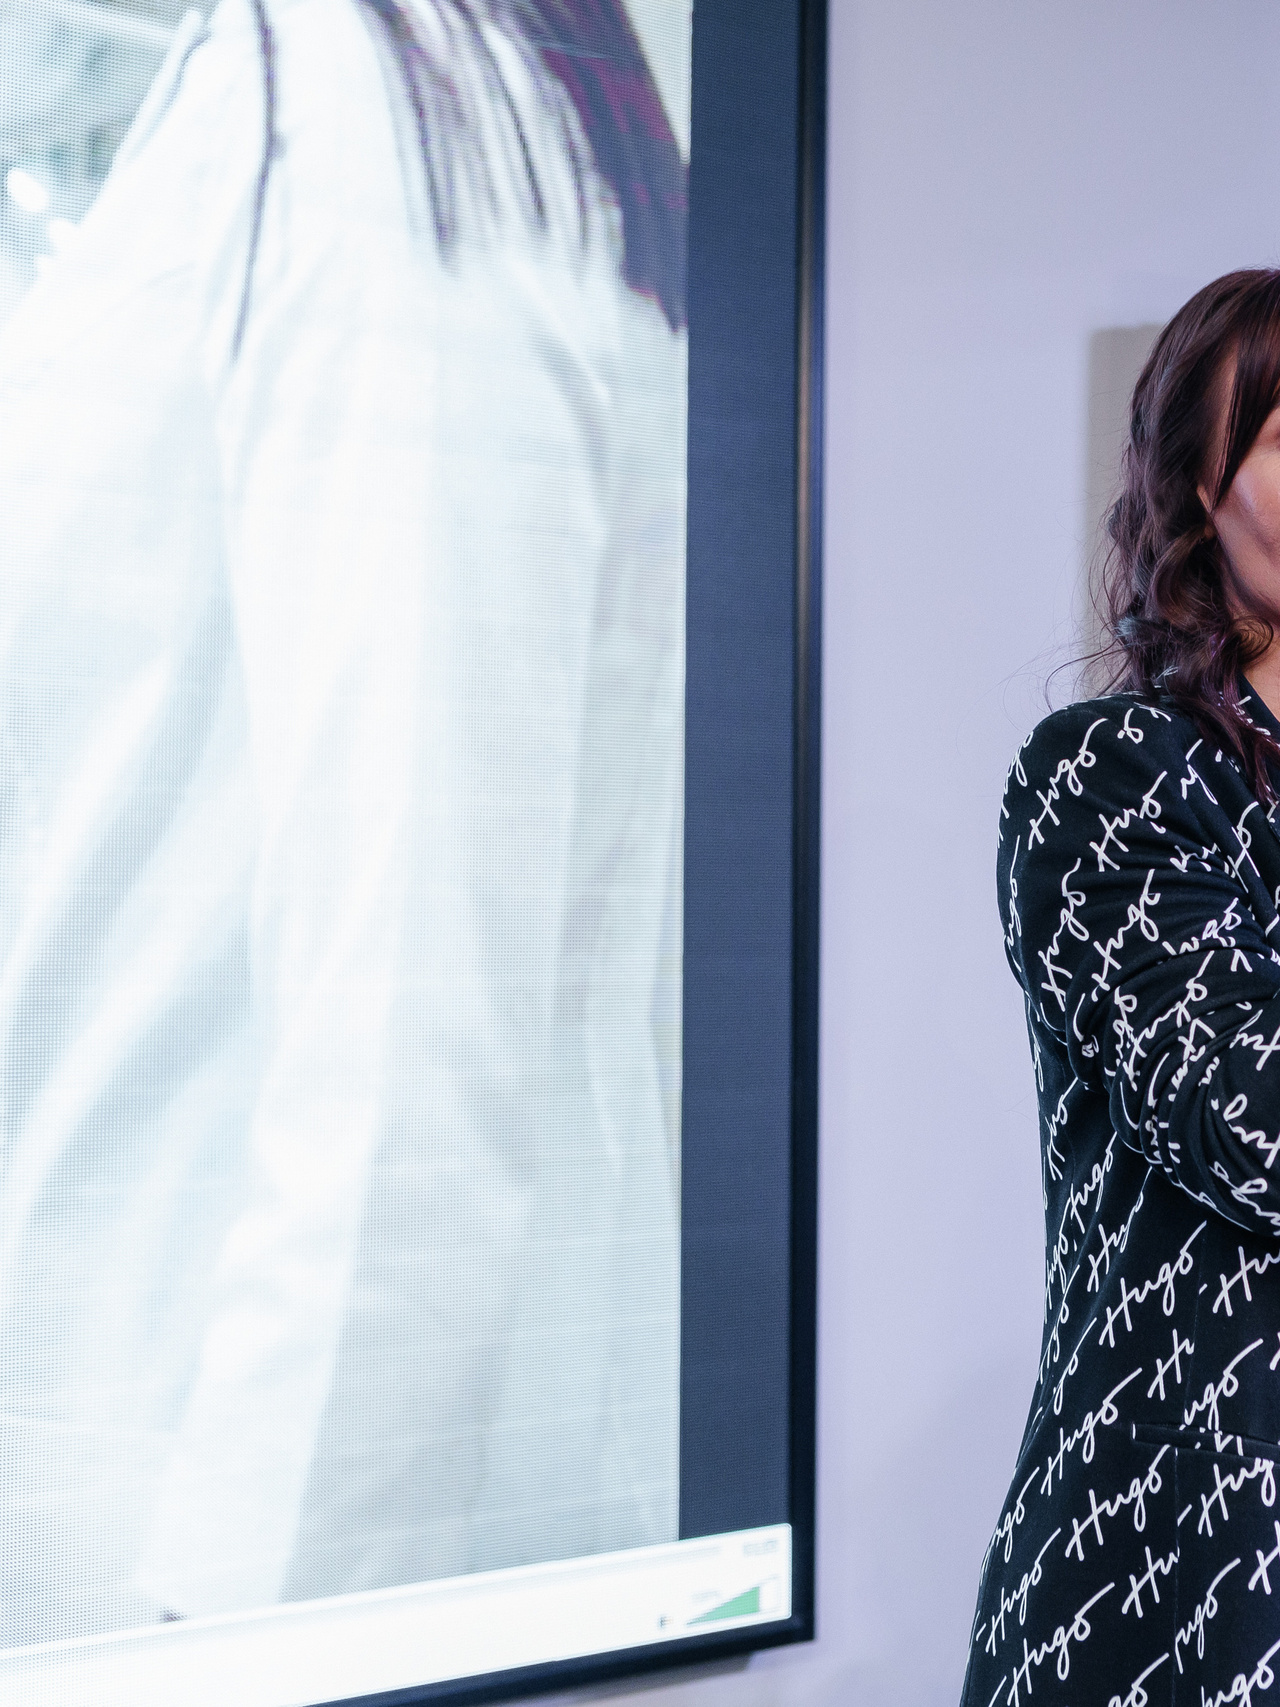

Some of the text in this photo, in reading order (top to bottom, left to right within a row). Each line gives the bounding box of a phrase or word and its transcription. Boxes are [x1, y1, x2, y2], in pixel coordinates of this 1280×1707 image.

[1028, 718, 1109, 851] Hugo
[1037, 857, 1090, 1013] Hugo
[1099, 1219, 1208, 1348] Hugo
[1040, 1367, 1143, 1497] Hugo
[1066, 1444, 1172, 1562] Hugo
[986, 1527, 1062, 1657] Hugo
[1007, 1581, 1116, 1707] Hugo
